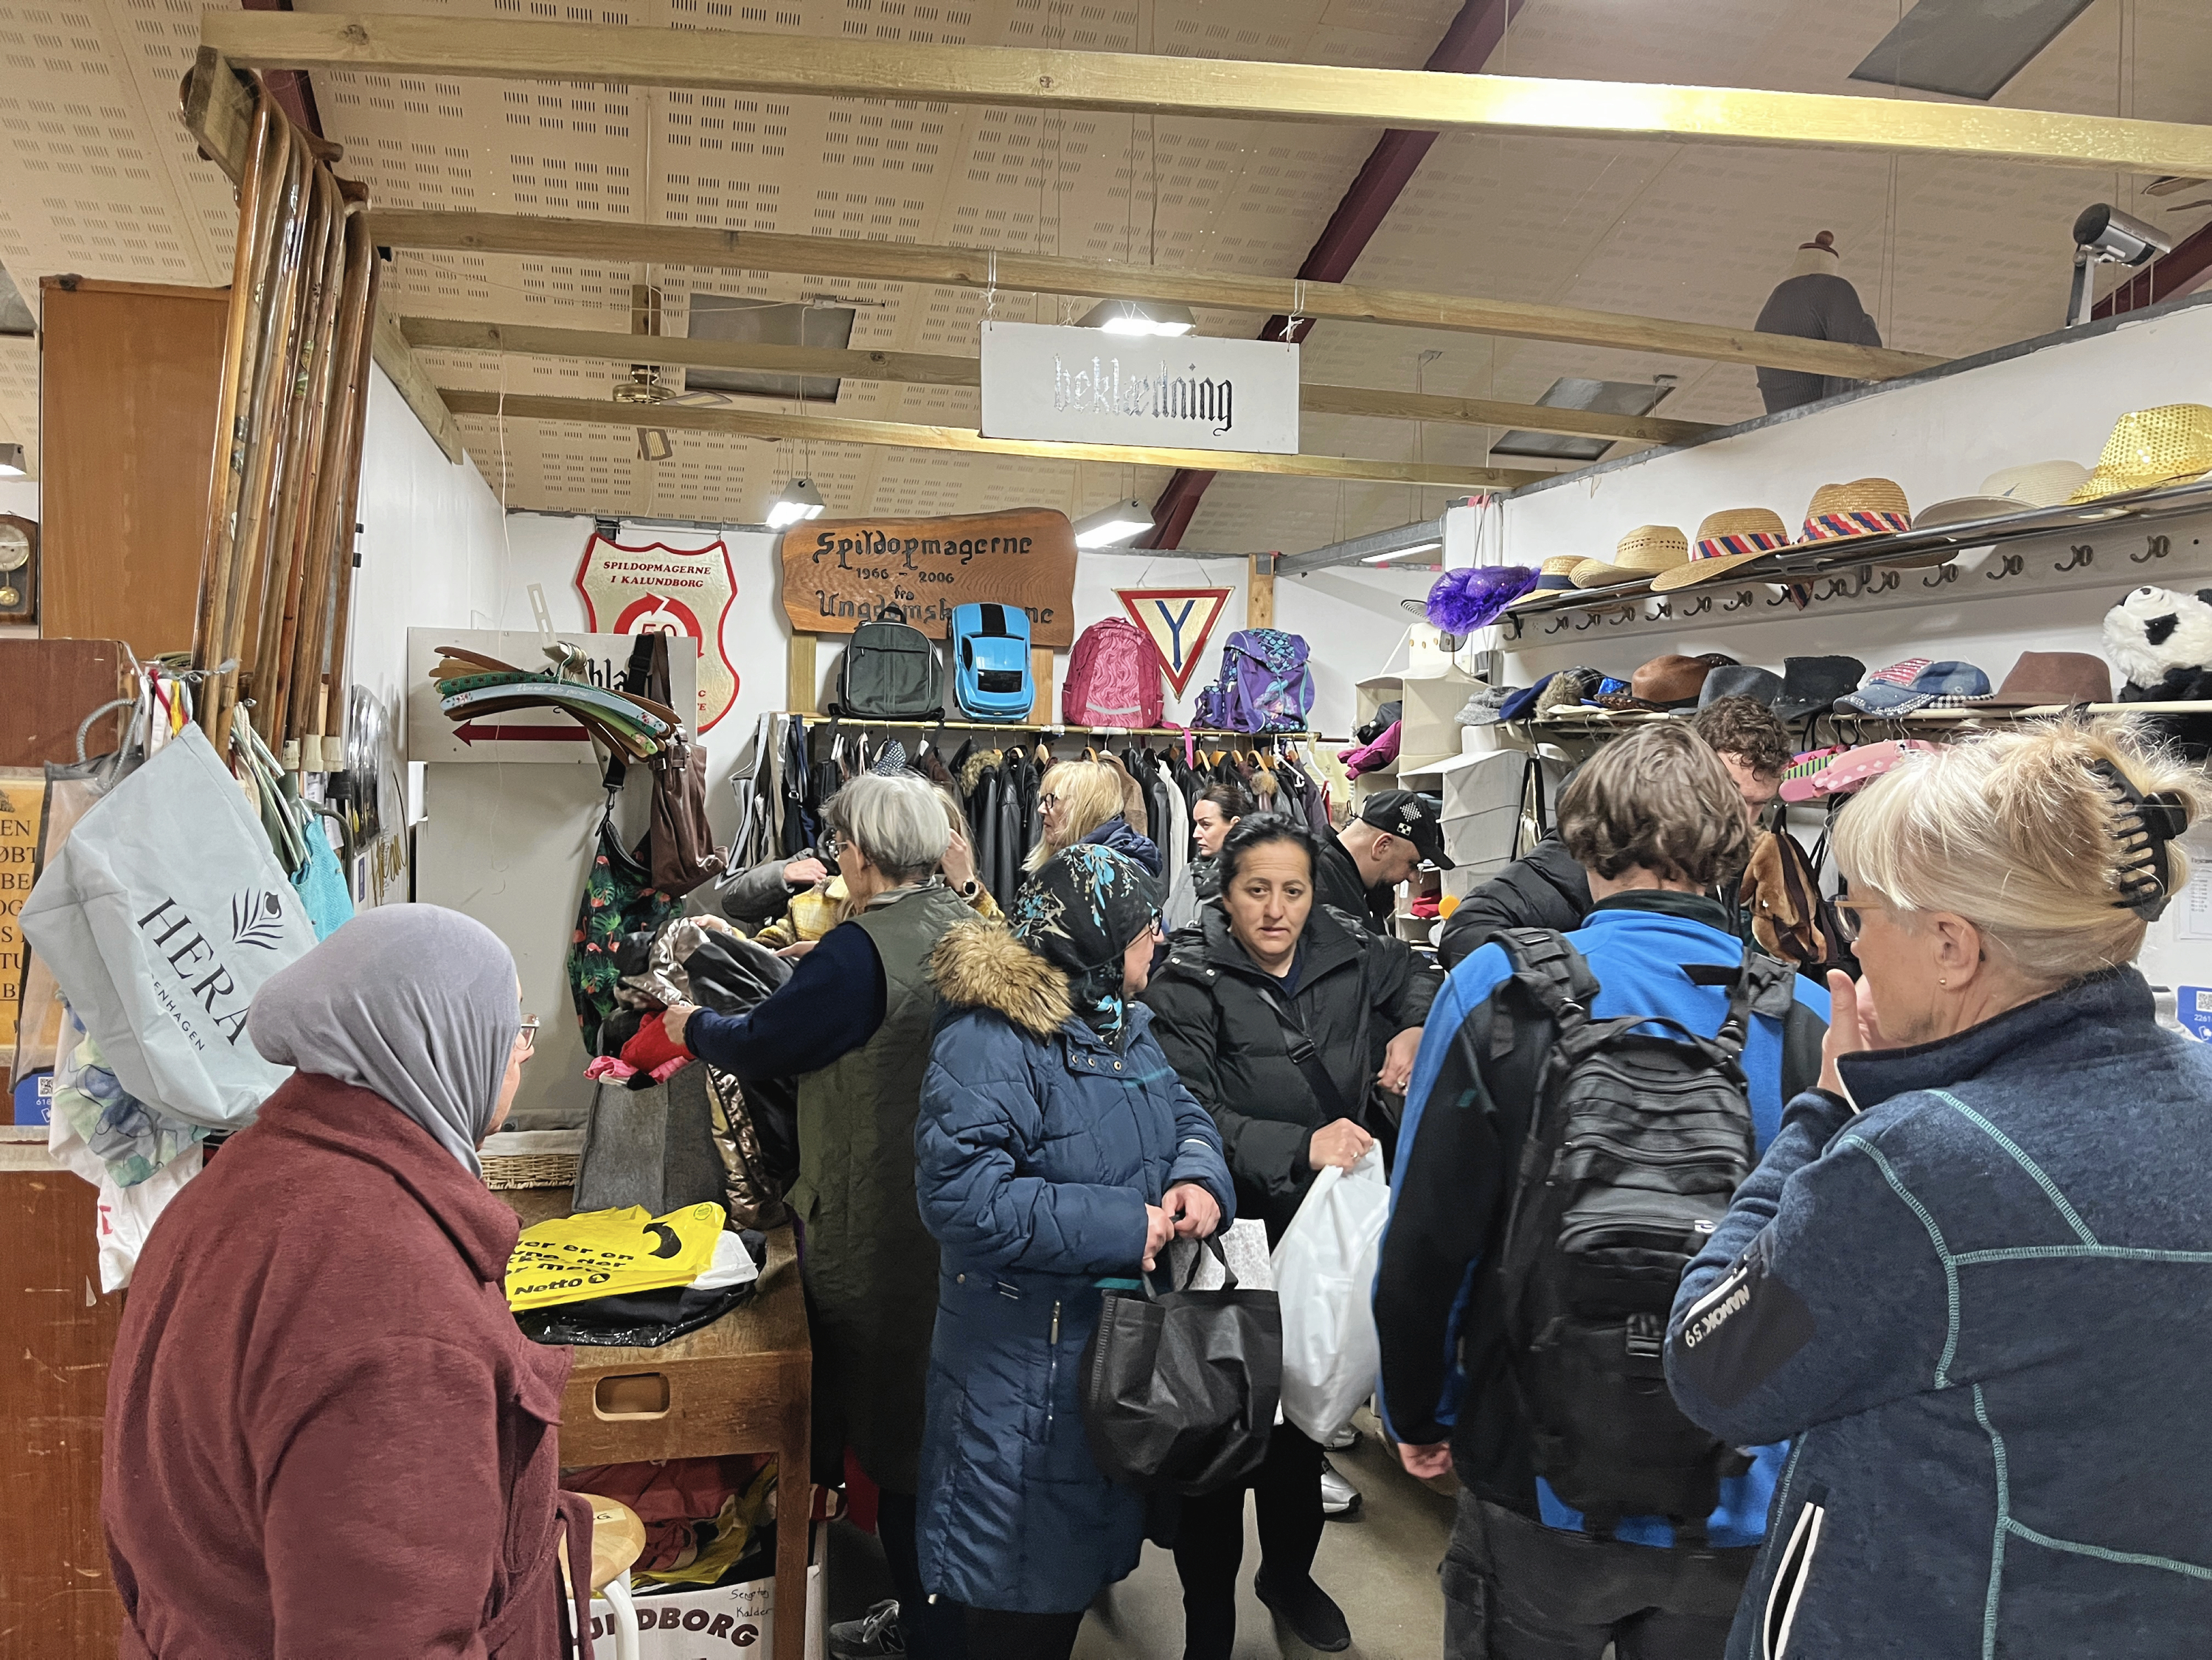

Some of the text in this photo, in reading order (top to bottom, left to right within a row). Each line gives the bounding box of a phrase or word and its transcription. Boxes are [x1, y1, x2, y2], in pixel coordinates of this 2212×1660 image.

[813, 530, 1032, 570] Spildopmagerne
[603, 561, 712, 574] SPILDOPMAGERNE
[856, 568, 888, 580] 1966
[919, 572, 954, 583] 2006
[621, 577, 704, 588] KALUNDBORG
[894, 585, 914, 600] fra
[137, 896, 251, 1046] HERA
[563, 1244, 594, 1254] er
[600, 1251, 634, 1261] en
[514, 1277, 583, 1296] Netto
[1685, 1284, 1750, 1348] NANOK 59
